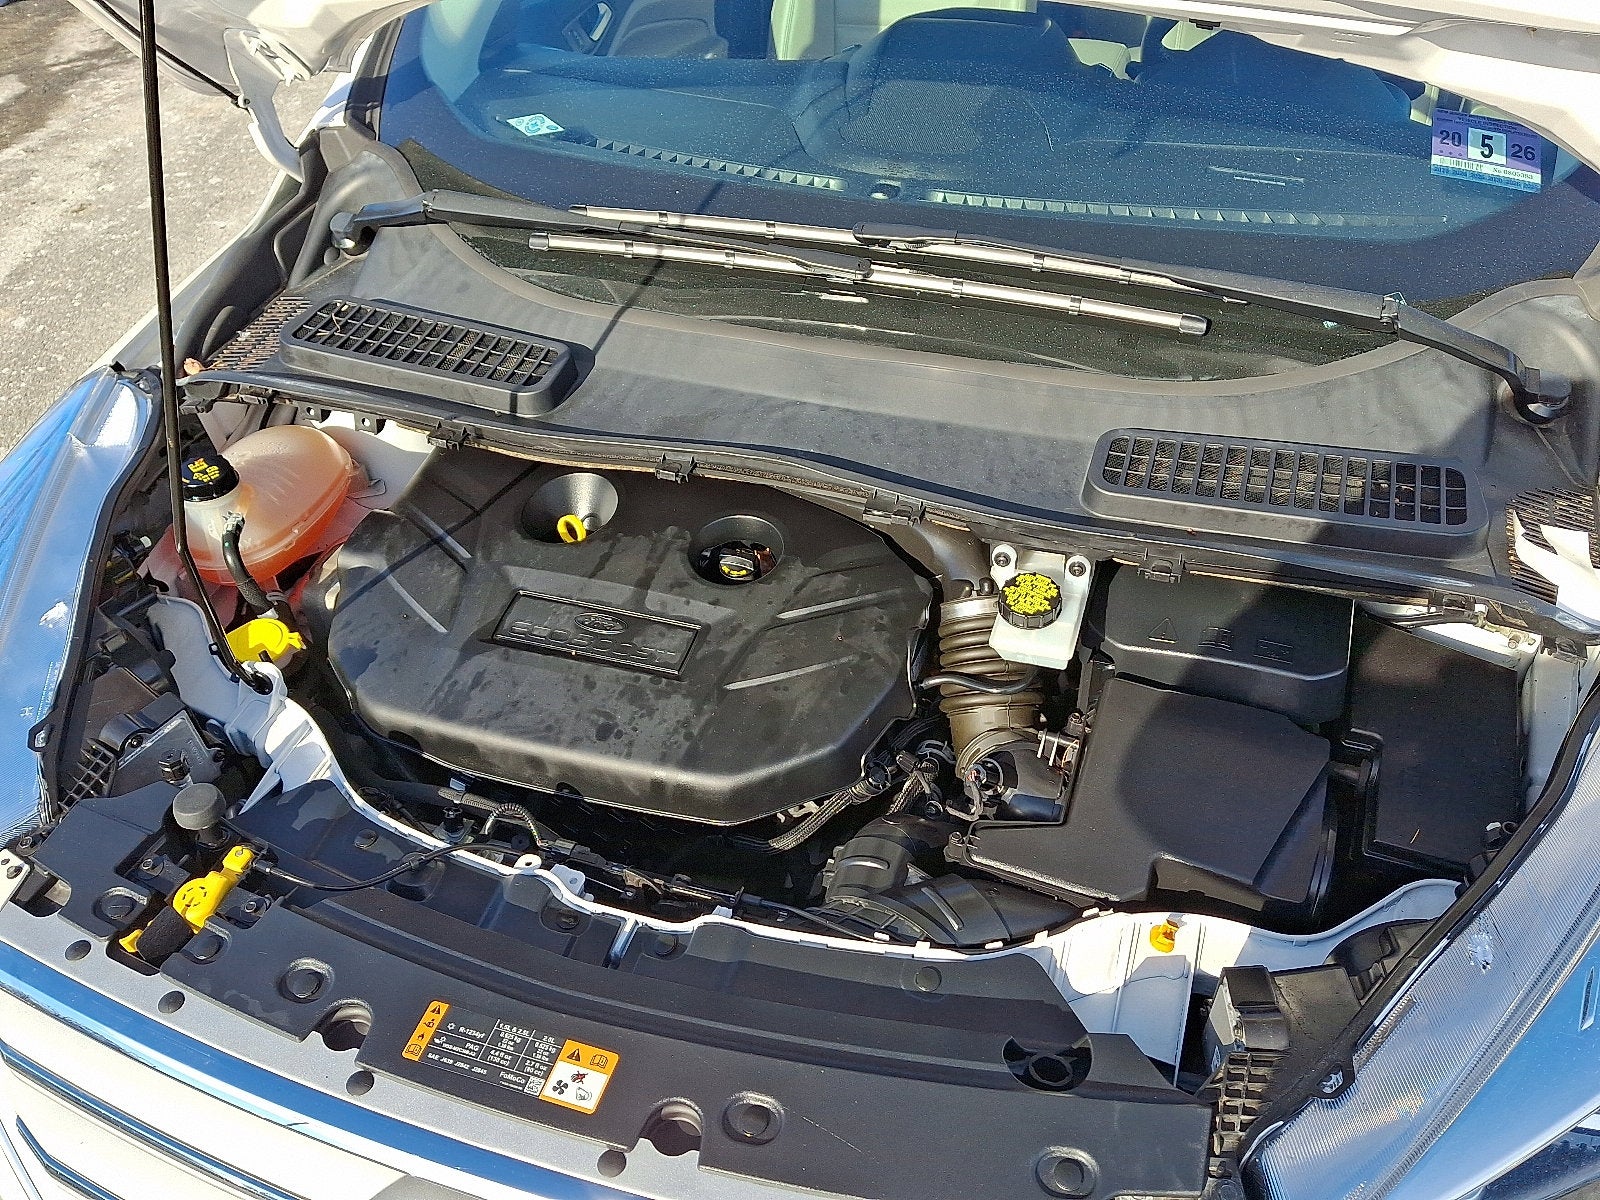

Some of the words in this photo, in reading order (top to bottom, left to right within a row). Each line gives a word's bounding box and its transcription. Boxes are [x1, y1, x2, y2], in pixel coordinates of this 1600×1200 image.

[1439, 130, 1462, 147] 20
[1480, 134, 1494, 159] 5
[1510, 143, 1536, 161] 26
[458, 1026, 486, 1039] R-1234yf
[542, 1035, 556, 1044] 2.0L
[464, 1042, 480, 1052] PAG
[427, 1052, 440, 1061] SAE
[499, 1071, 526, 1084] FoMoCo
